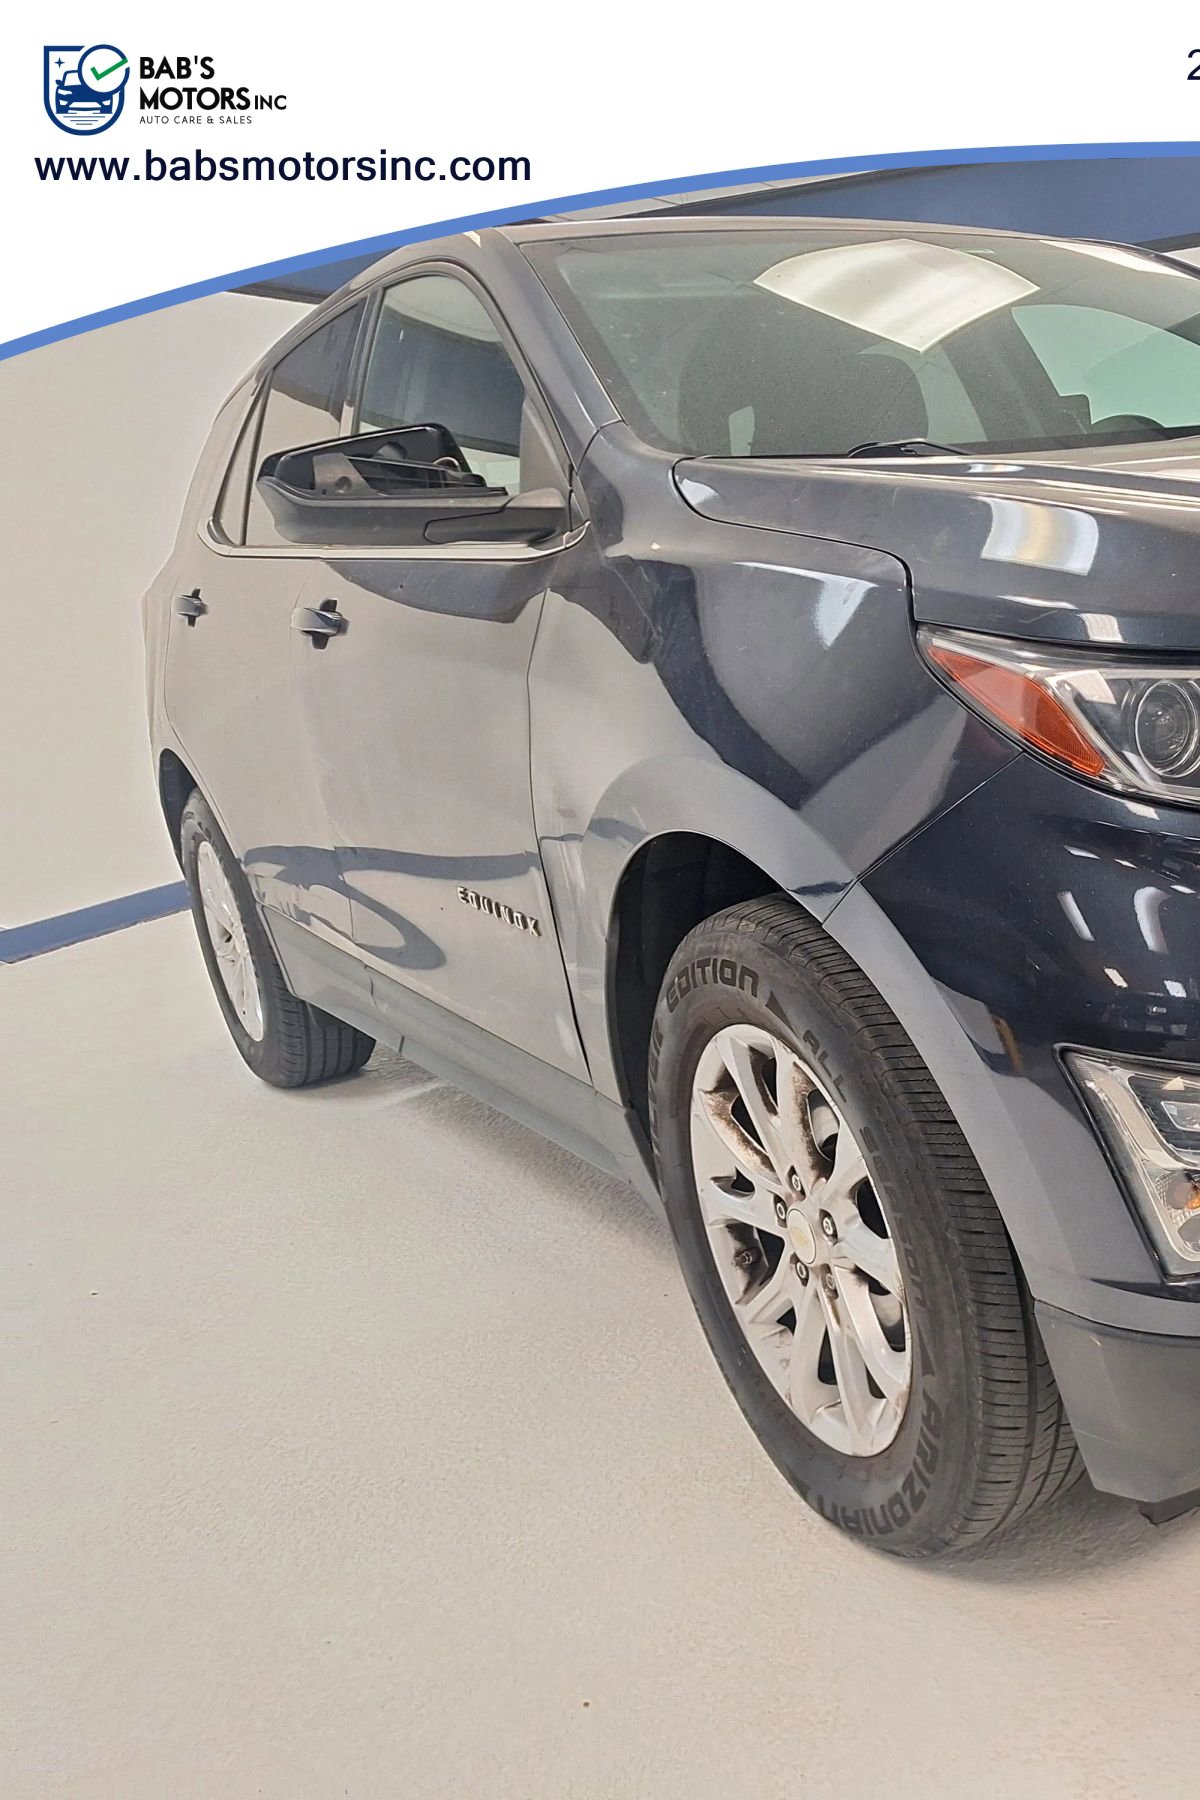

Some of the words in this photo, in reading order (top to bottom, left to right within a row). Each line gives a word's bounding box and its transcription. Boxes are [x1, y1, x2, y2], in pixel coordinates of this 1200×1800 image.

[457, 886, 542, 937] EQUINOX
[666, 956, 760, 1013] EDITION
[802, 1029, 848, 1104] ALL
